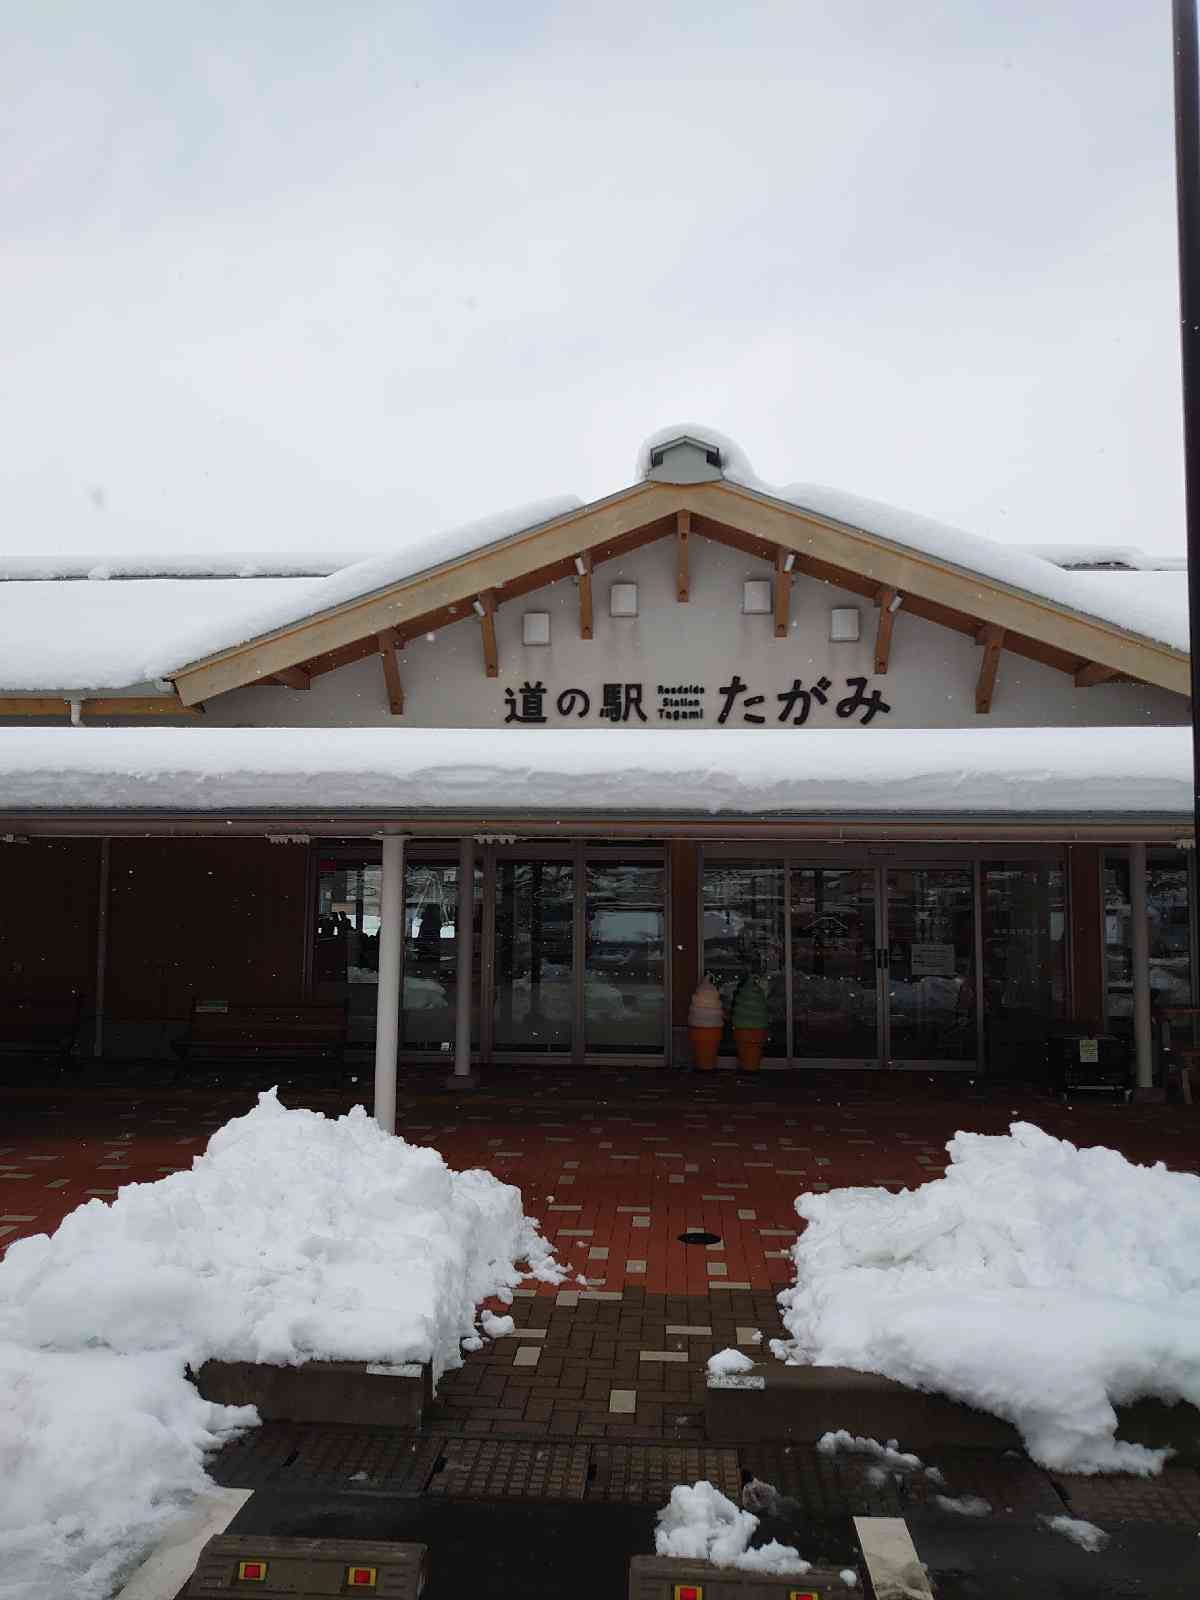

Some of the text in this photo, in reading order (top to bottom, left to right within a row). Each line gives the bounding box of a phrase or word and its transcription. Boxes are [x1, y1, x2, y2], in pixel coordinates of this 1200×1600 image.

[504, 675, 891, 725] 道の駅 たがみ
[662, 697, 700, 707] Station
[657, 708, 703, 721] Tagami
